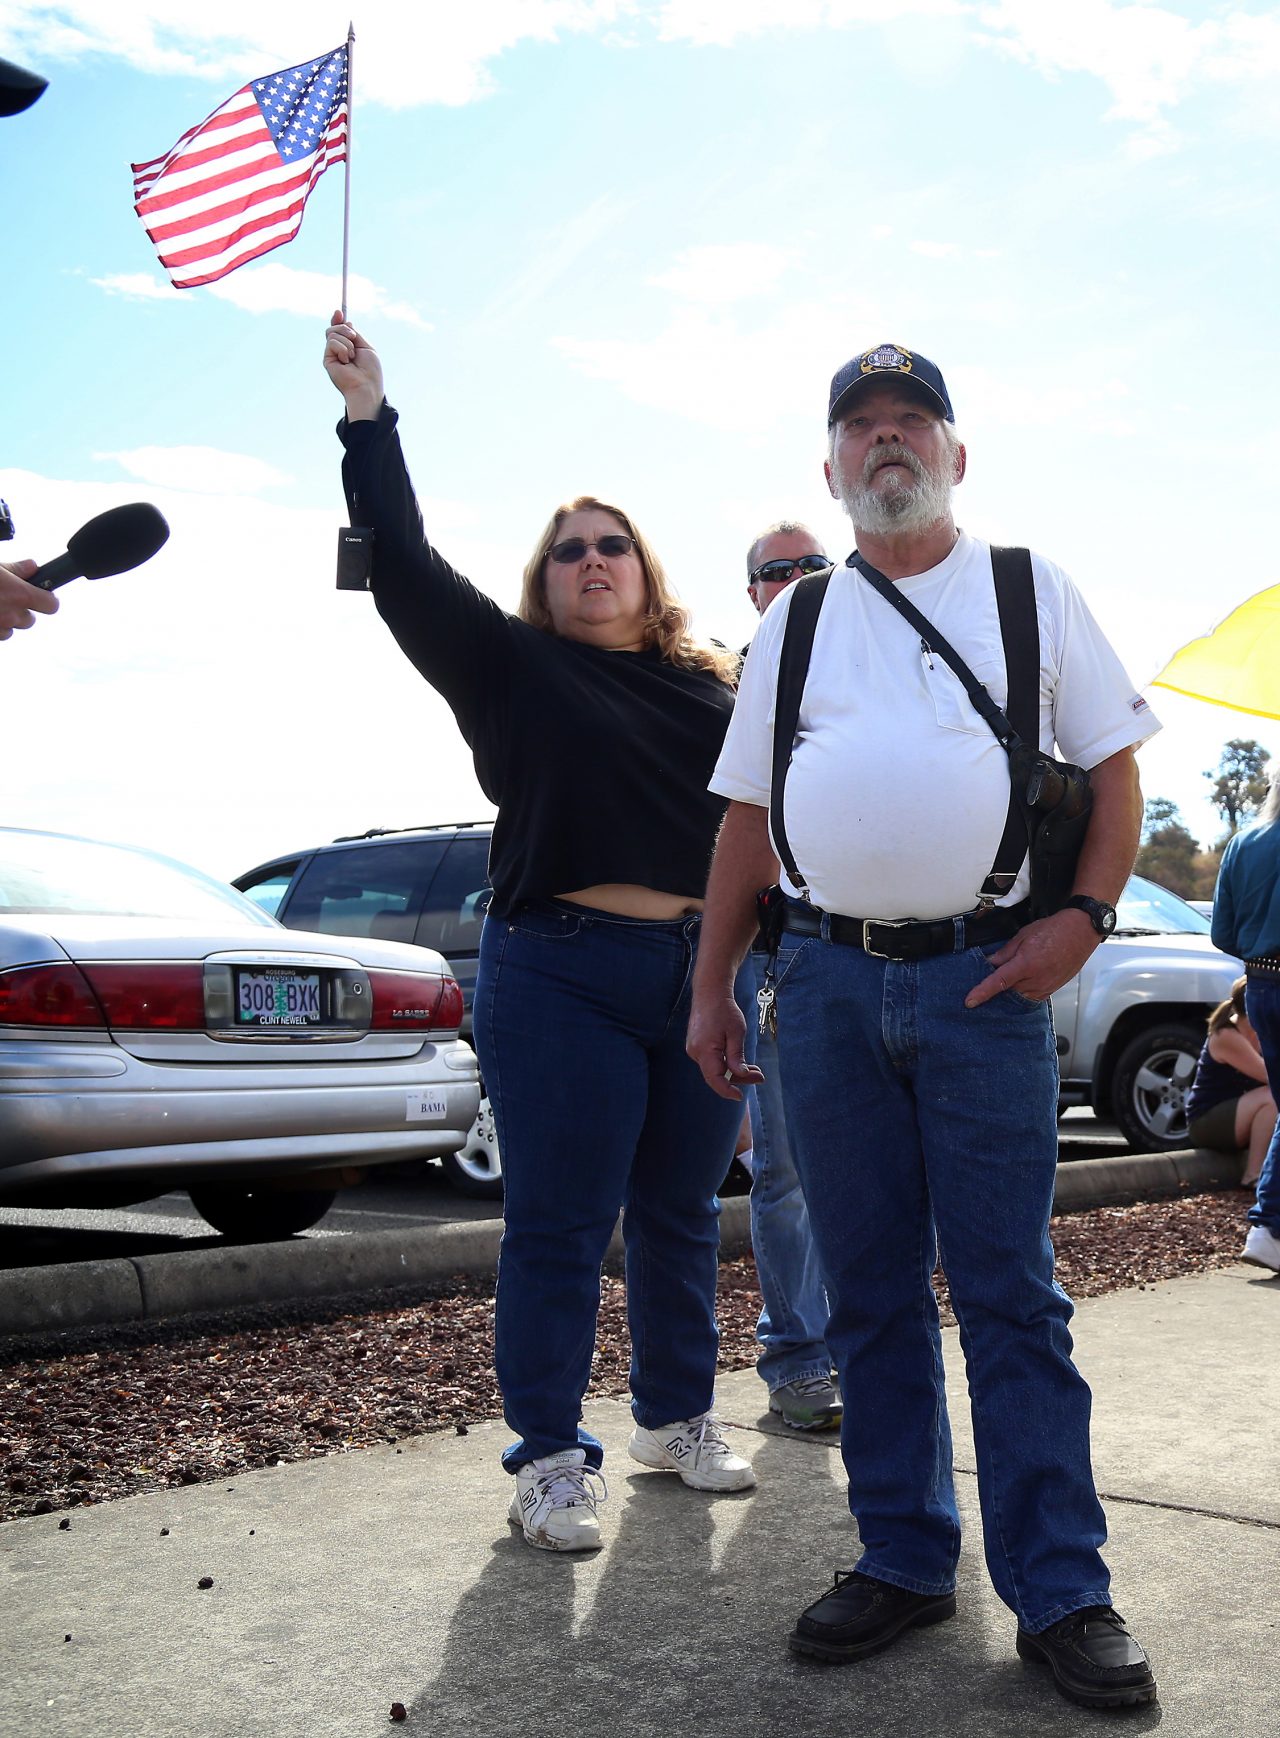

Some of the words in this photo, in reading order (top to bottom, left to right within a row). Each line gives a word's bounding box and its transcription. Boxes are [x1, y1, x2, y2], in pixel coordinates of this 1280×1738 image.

[263, 974, 295, 983] Oregon
[241, 983, 275, 1011] 308
[287, 983, 319, 1012] BXK
[259, 1016, 279, 1025] CLINT
[280, 1016, 307, 1025] NEWELL
[420, 1102, 446, 1113] BAMA
